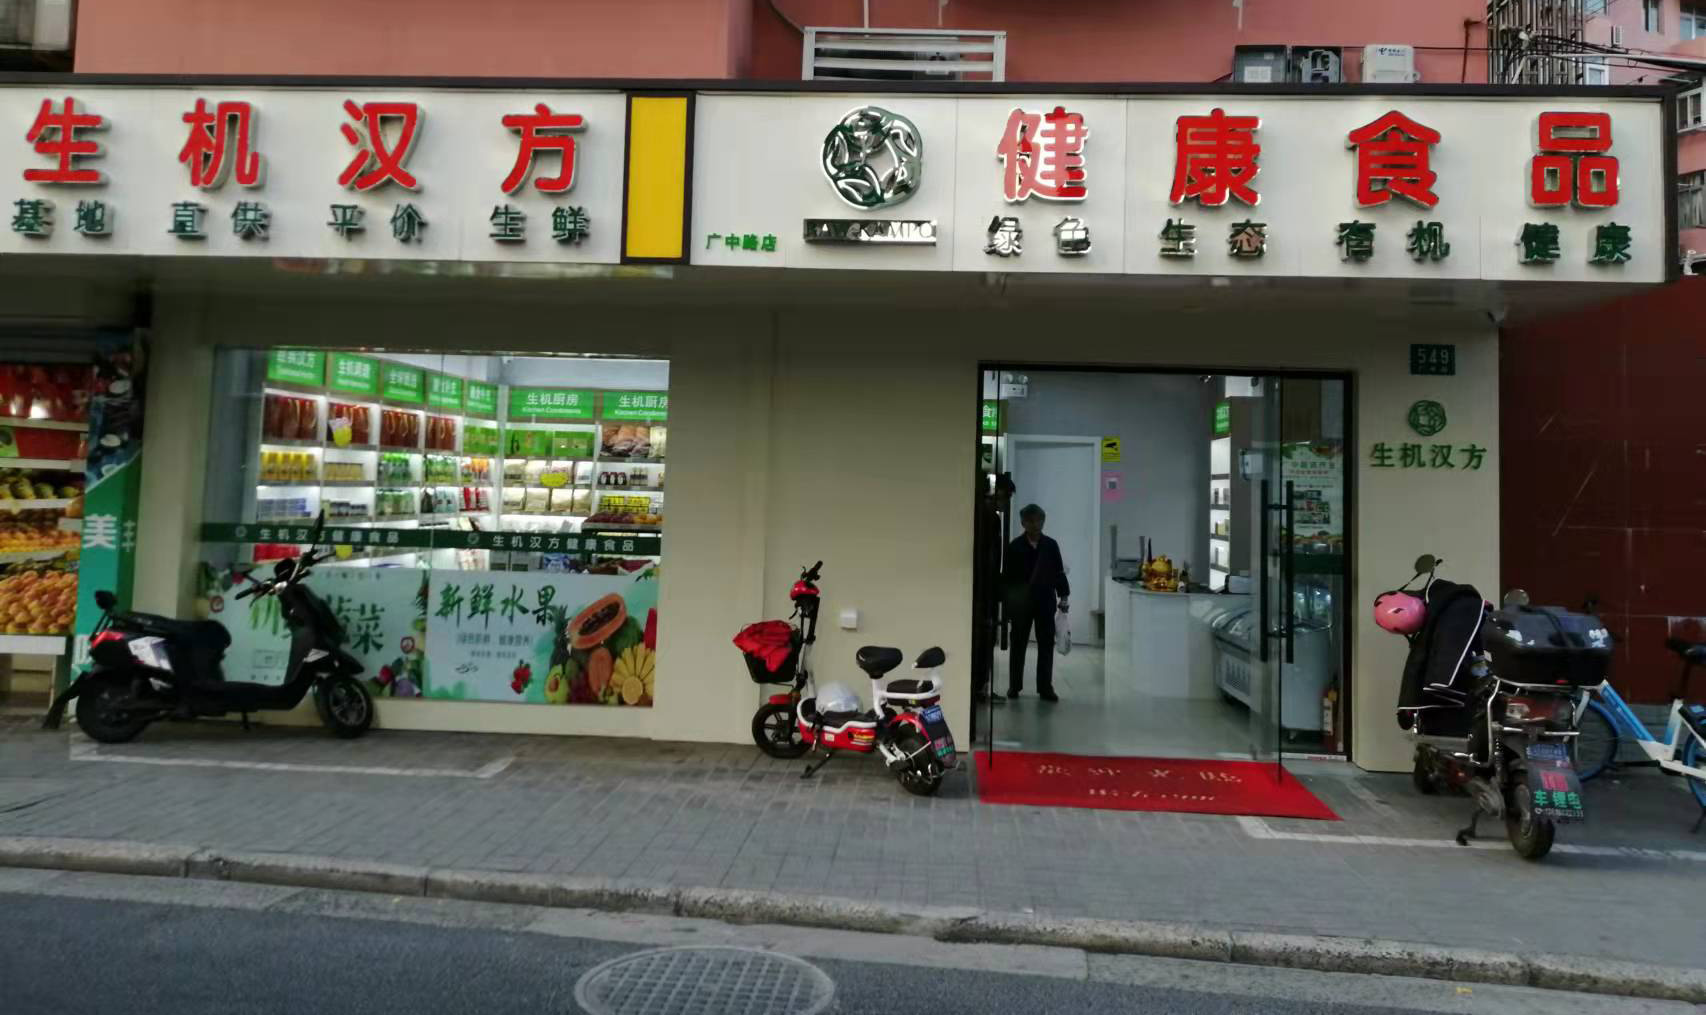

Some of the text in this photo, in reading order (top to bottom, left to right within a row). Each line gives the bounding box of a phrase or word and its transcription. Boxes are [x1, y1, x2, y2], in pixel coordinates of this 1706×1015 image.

[23, 96, 587, 194] 生机汉方
[997, 106, 1621, 206] 健康食品
[705, 233, 777, 252] 广中路店
[1417, 348, 1449, 364] 549
[526, 392, 579, 407] 生机厨房
[1370, 442, 1488, 471] 生机汉方
[83, 513, 117, 549] 美
[492, 535, 635, 553] 生机汉方健康食品
[436, 583, 557, 630] 新鲜水果
